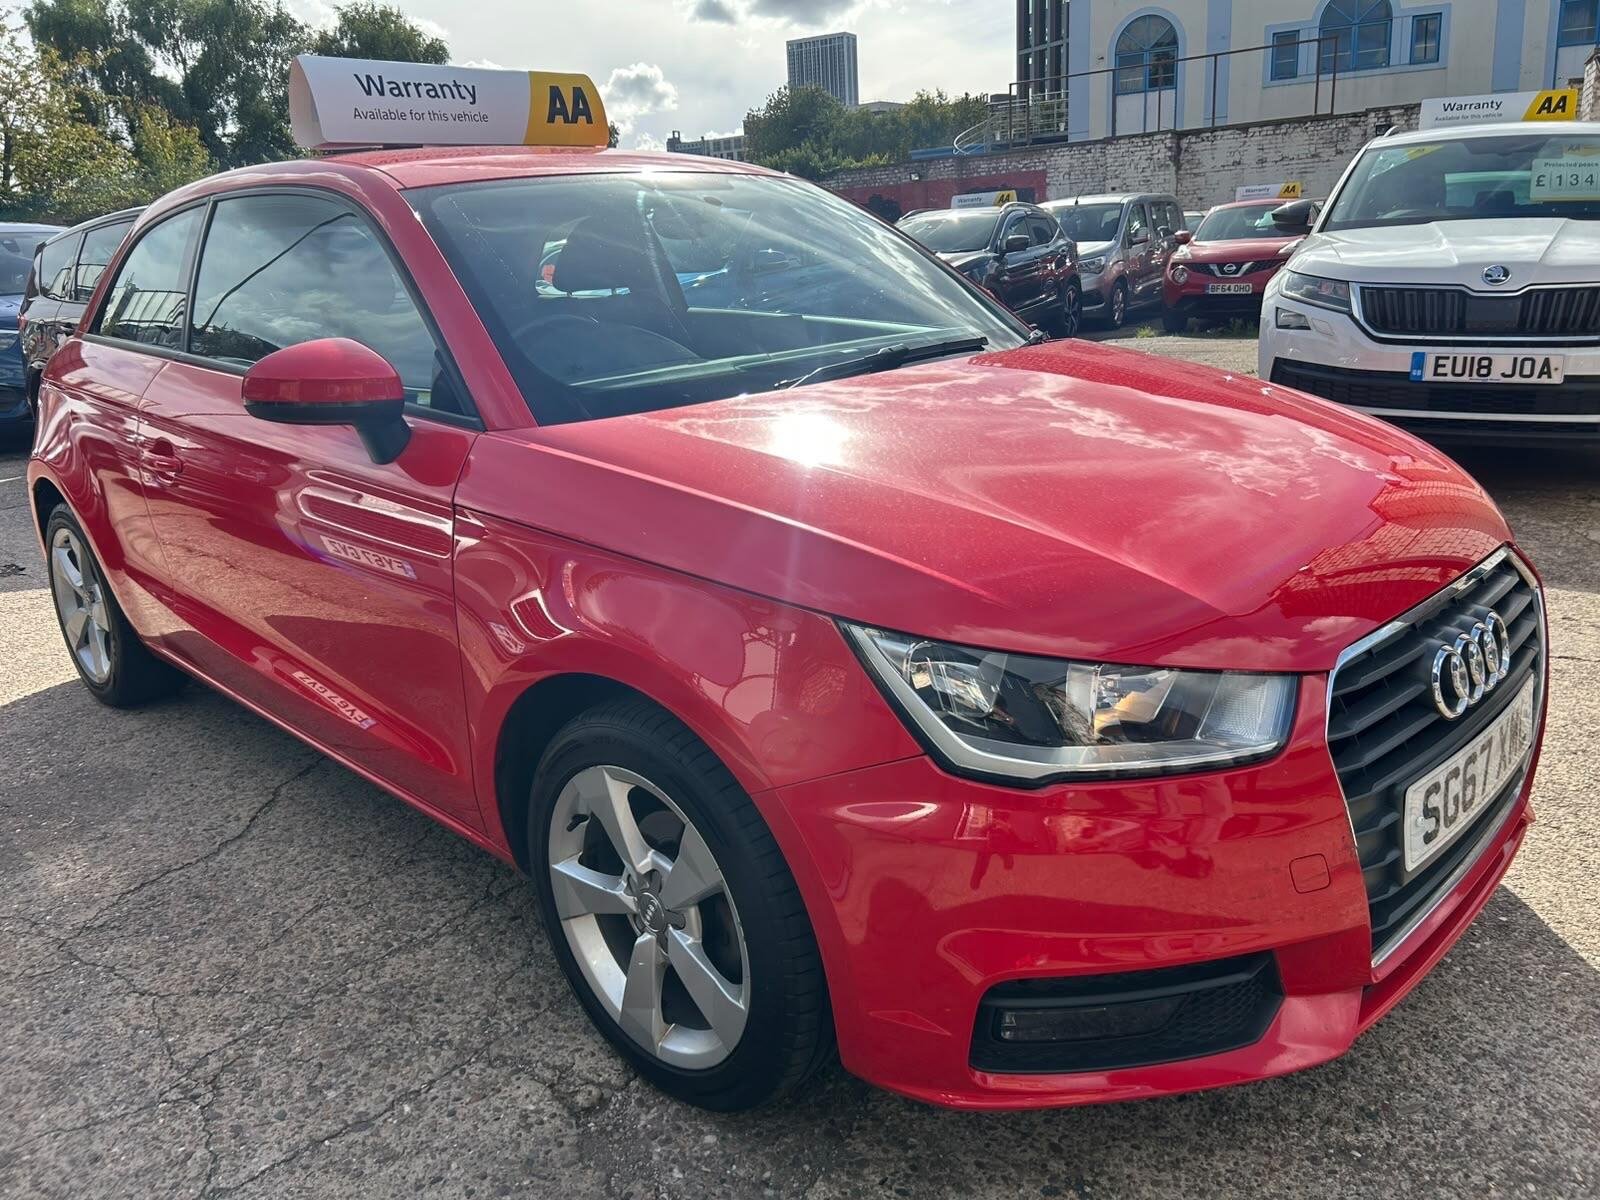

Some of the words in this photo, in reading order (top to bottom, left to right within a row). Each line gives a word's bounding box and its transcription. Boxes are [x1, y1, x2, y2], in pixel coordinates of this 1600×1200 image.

[353, 73, 477, 105] Warranty
[546, 85, 593, 125] AA
[1442, 99, 1503, 112] Warranty
[1536, 95, 1568, 115] AA
[353, 107, 407, 121] Available
[409, 109, 425, 121] for
[428, 110, 449, 122] this
[450, 111, 489, 123] vehicle
[998, 192, 1011, 203] AA
[1283, 184, 1296, 194] AA
[1210, 284, 1232, 293] BF64
[1432, 355, 1493, 378] EU18
[1500, 356, 1553, 379] JOA
[1422, 735, 1494, 845] SG67
